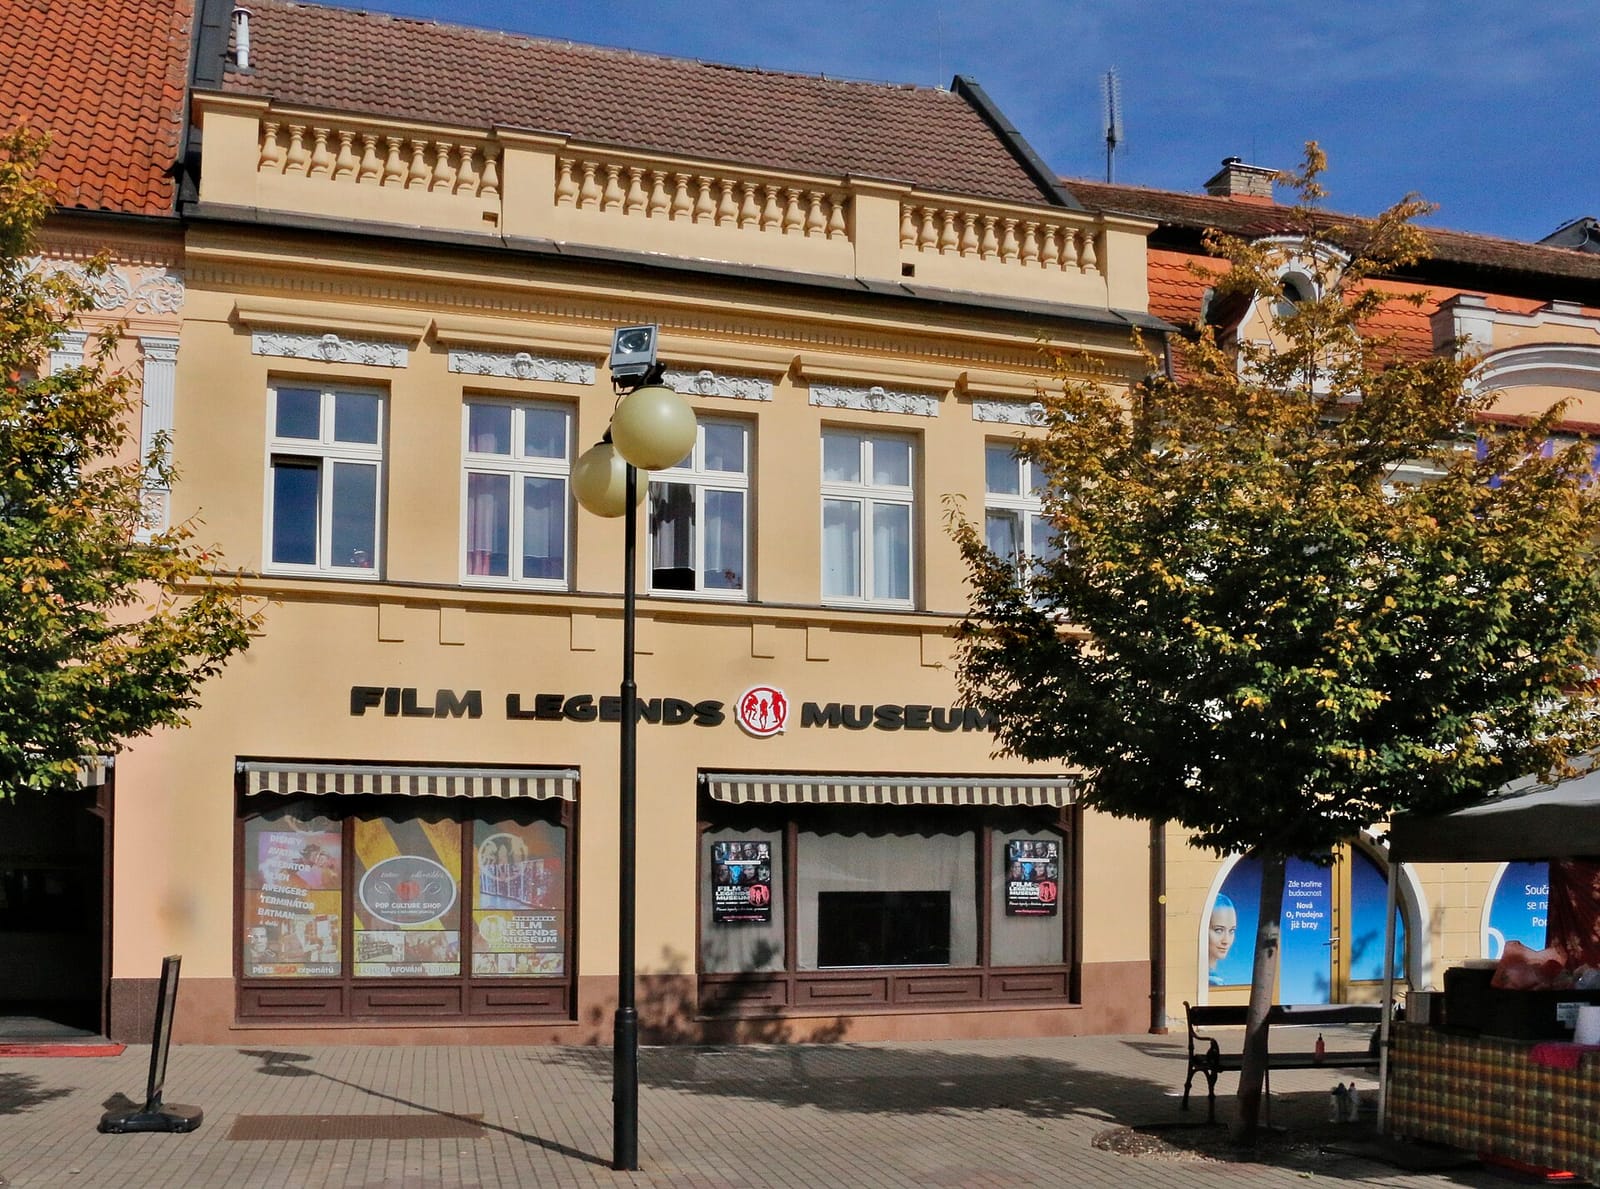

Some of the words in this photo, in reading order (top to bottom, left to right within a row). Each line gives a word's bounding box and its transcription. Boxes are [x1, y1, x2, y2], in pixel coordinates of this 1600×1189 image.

[350, 685, 483, 720] FILM
[506, 692, 726, 728] LEGENDS
[800, 701, 998, 733] MUSEUM
[1288, 880, 1300, 888] Zde
[1300, 880, 1322, 888] tvoříme
[261, 883, 309, 897] AVENGERS
[1288, 889, 1322, 897] budoucnost
[260, 894, 315, 911] TERMINÁTOR
[391, 902, 421, 910] CULTURE
[1526, 901, 1537, 910] se
[257, 907, 297, 920] BATMAN
[1295, 911, 1324, 919] Prodejna
[506, 921, 543, 929] FILM
[1291, 920, 1300, 931] již
[1301, 920, 1318, 931] brzy
[502, 929, 558, 937] LEGENDS
